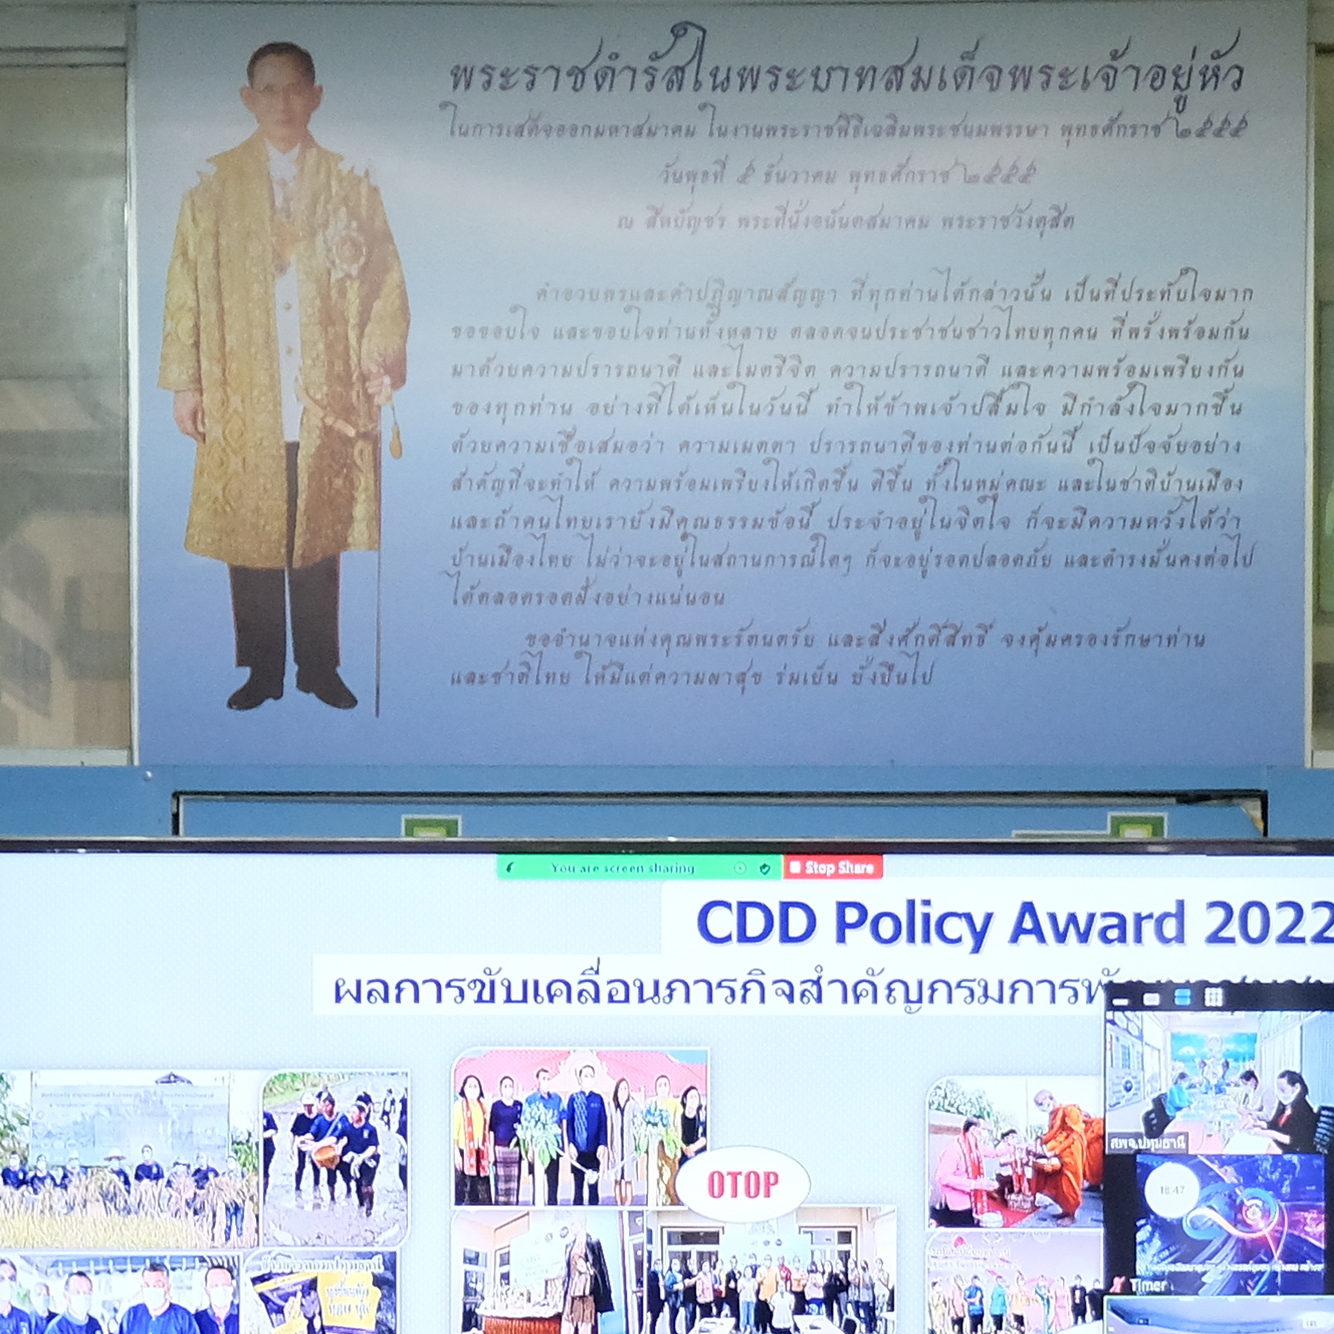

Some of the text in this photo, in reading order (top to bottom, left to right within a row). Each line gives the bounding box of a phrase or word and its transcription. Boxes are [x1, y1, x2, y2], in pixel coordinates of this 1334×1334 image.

[449, 20, 1245, 114] พระราชดำรัสในพระบาทสมเด็จพระเจ้าอยู่หัว
[439, 100, 696, 139] ในการเสด็จออกมหาสมาคม
[551, 861, 576, 874] You
[579, 863, 601, 874] are
[804, 860, 875, 877] Stop Share
[696, 899, 818, 946] CDD
[835, 897, 993, 955] Policy
[1007, 897, 1187, 946] Award
[707, 1169, 780, 1200] OTOP
